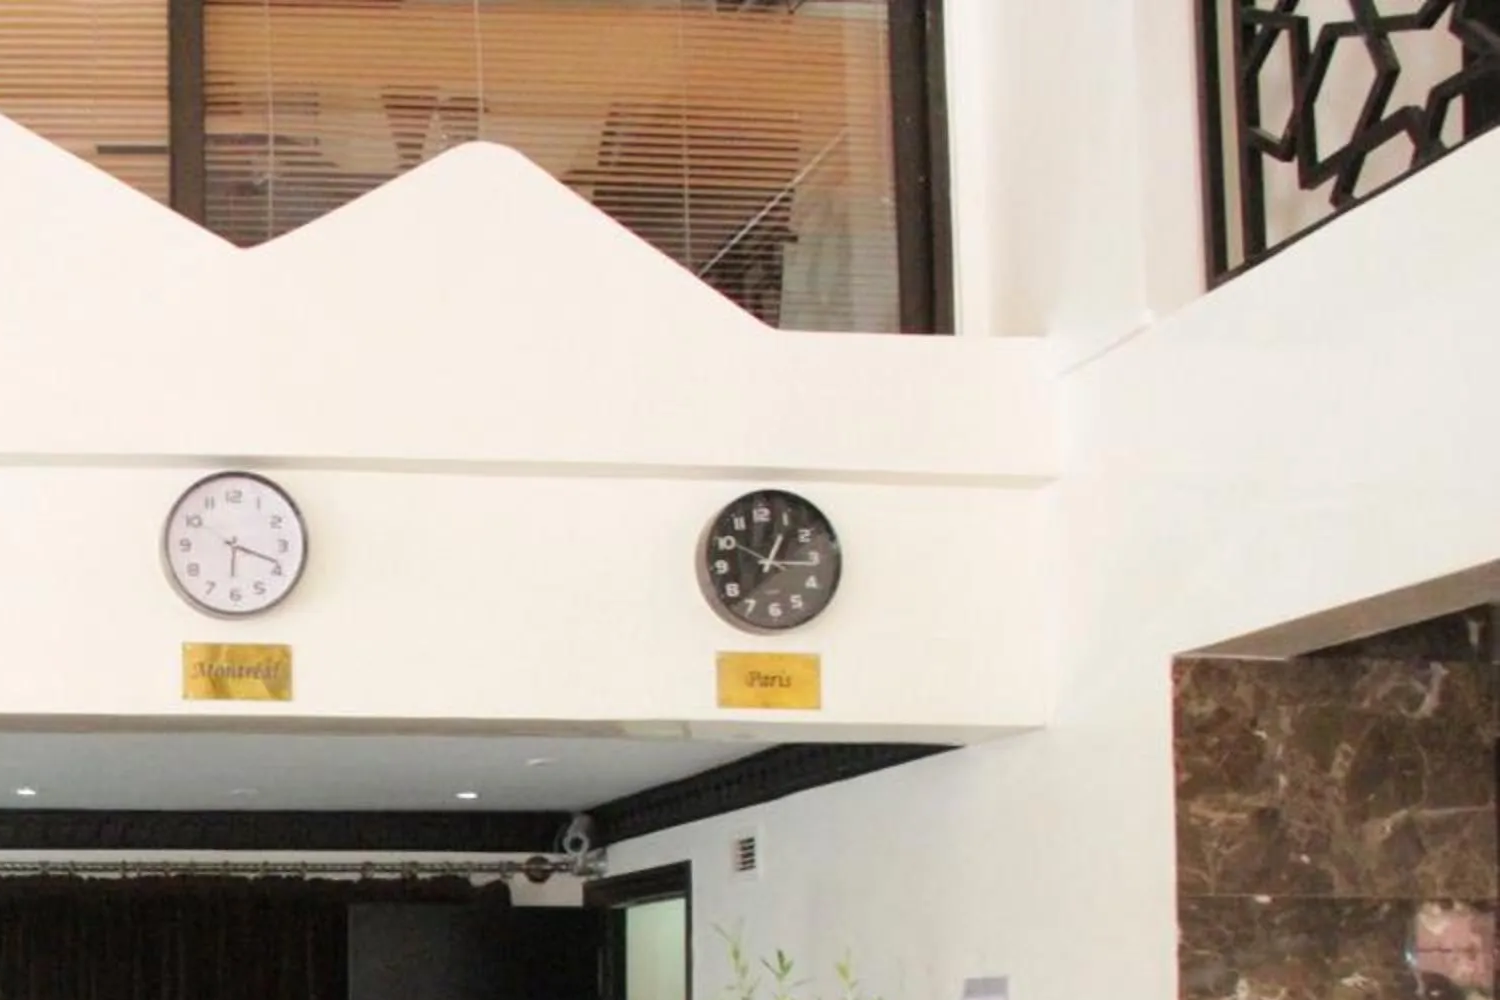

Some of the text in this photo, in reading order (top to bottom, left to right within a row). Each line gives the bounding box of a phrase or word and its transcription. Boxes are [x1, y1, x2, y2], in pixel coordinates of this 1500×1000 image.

[204, 496, 215, 509] 11
[225, 490, 243, 504] 12
[185, 515, 203, 528] 10
[753, 507, 770, 522] 12
[269, 515, 283, 529] 2
[733, 516, 746, 530] 11
[717, 535, 736, 550] 10
[798, 528, 811, 543] 2
[179, 538, 192, 552] 9
[277, 539, 289, 553] 3
[807, 551, 820, 566] 3
[187, 563, 200, 577] 8
[271, 562, 283, 576] 4
[714, 559, 729, 574] 9
[205, 581, 216, 595] 7
[253, 581, 267, 595] 5
[804, 575, 818, 589] 4
[229, 588, 242, 602] 6
[725, 583, 740, 597] 8
[744, 598, 756, 616] 7
[789, 594, 803, 609] 5
[768, 603, 782, 617] 6
[745, 669, 792, 688] Paris
